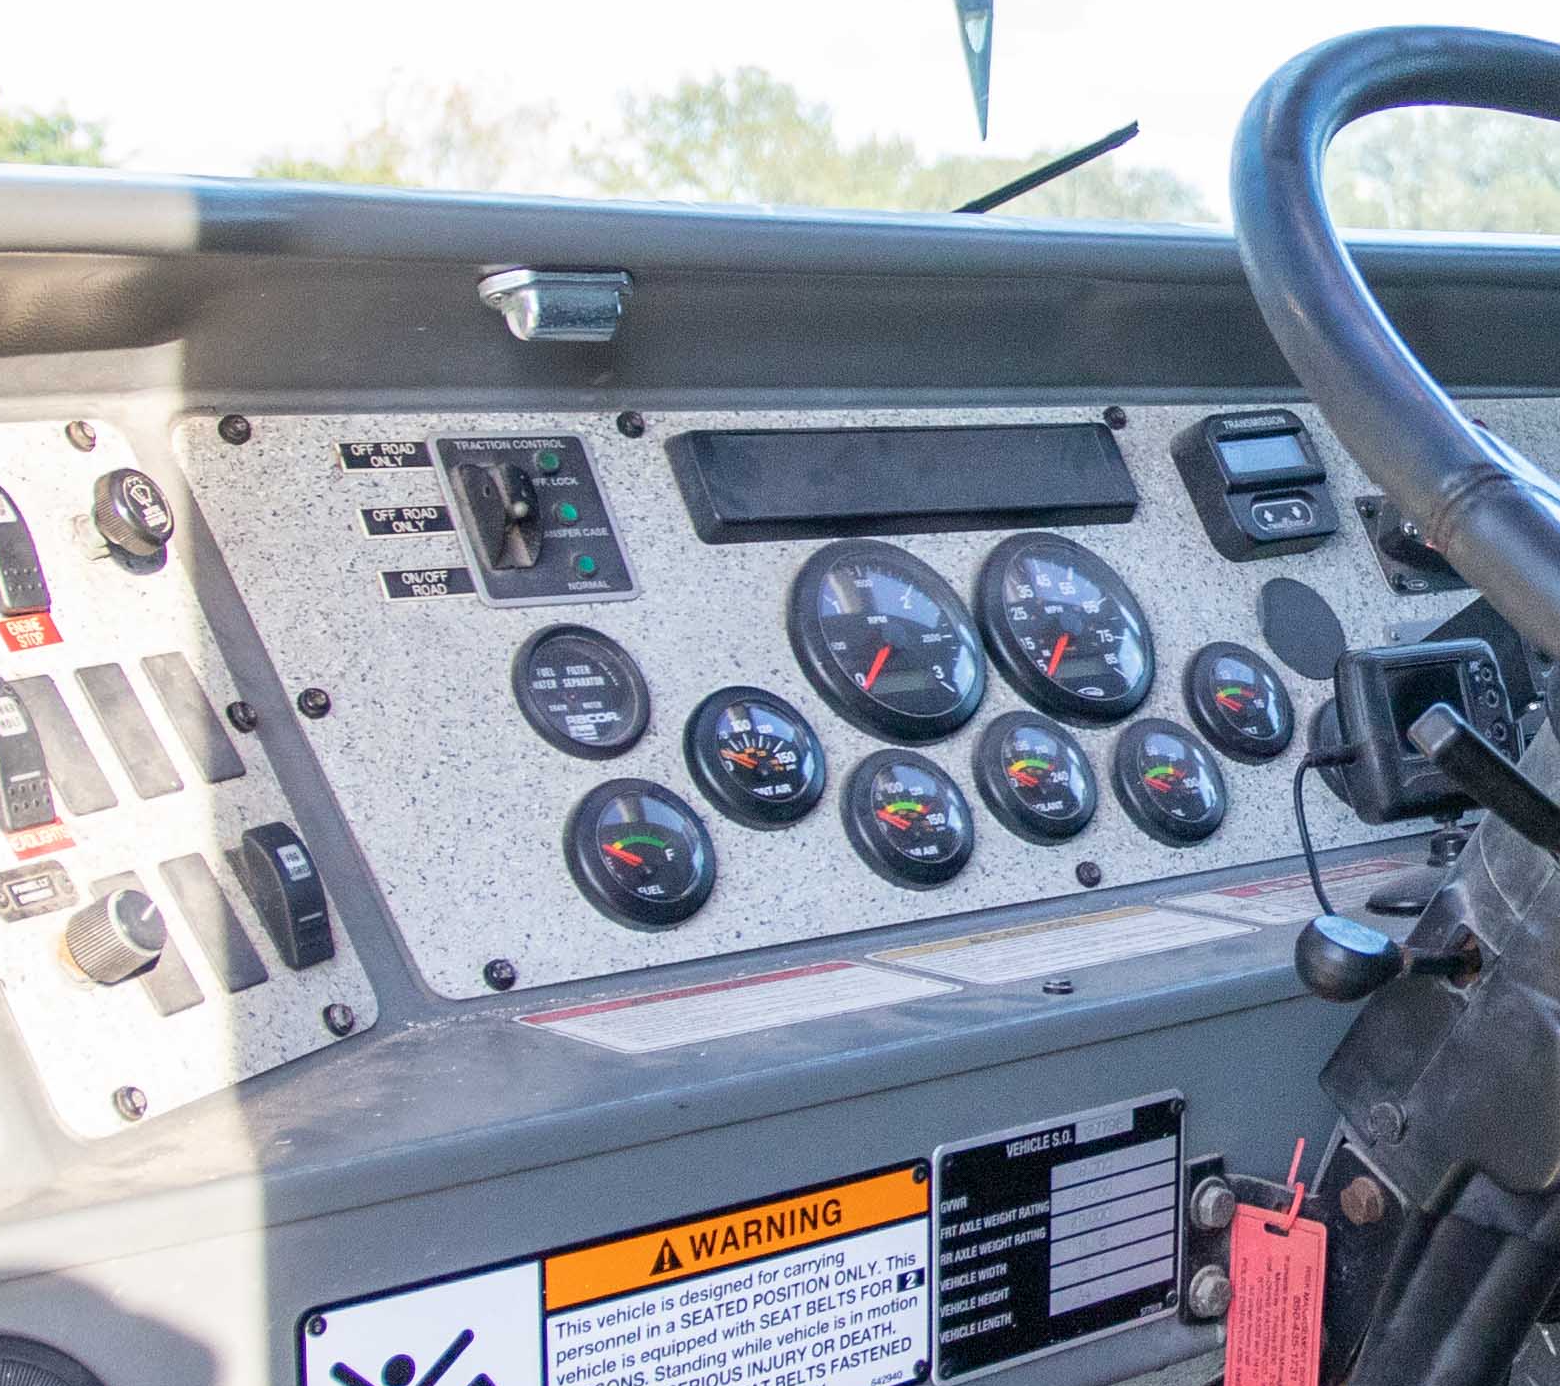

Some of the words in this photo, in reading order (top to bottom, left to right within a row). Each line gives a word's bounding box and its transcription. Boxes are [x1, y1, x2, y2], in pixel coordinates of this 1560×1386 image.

[1223, 416, 1286, 429] TRANSMISSION
[351, 444, 376, 456] OFF
[382, 443, 415, 455] ROAD
[454, 440, 511, 450] TRACTION
[514, 439, 566, 449] CONTROL
[370, 456, 403, 467] ONLY
[551, 477, 579, 486] LOCK
[372, 510, 396, 522] OFF
[403, 507, 437, 519] ROAD
[392, 521, 425, 533] ONLY
[582, 527, 609, 537] CASE
[401, 570, 448, 585] ON/OFF
[412, 584, 448, 596] ROAD
[568, 580, 611, 591] NORMAL
[1017, 584, 1034, 598] 35
[1059, 582, 1076, 595] 55
[1010, 607, 1027, 621] 25
[1044, 605, 1064, 614] MPH
[6, 618, 44, 635] ENGINE
[866, 616, 888, 624] RPM
[16, 631, 45, 648] STOP
[1096, 629, 1114, 643] 75
[1020, 637, 1035, 650] 15
[536, 667, 556, 677] FUEL
[566, 665, 591, 675] FILTER
[932, 665, 945, 680] 3
[562, 676, 605, 688] SEPARATOR
[854, 673, 866, 687] 0
[776, 751, 796, 764] 150
[1050, 771, 1068, 783] 240
[774, 784, 792, 795] AIR
[926, 814, 944, 825] 150
[664, 848, 675, 861] F
[923, 846, 938, 856] AIR
[638, 884, 664, 895] FUEL
[1006, 1133, 1050, 1158] VEHICLE
[1052, 1130, 1073, 1145] S.O.
[940, 1196, 968, 1214] GVWR
[940, 1224, 957, 1240] FRT
[959, 1218, 982, 1236] AXLE
[983, 1209, 1017, 1230] WEIGHT
[1019, 1200, 1049, 1219] RATING
[689, 1199, 842, 1262] WARNING
[940, 1254, 952, 1266] RR
[954, 1246, 978, 1263] AXLE
[979, 1237, 1013, 1256] WEIGHT
[1014, 1227, 1046, 1246] RATING
[940, 1271, 975, 1292] VEHICLE
[977, 1263, 1007, 1281] WIDTH
[556, 1319, 592, 1340] This
[597, 1301, 656, 1329] vehicle
[661, 1297, 674, 1311] is
[679, 1274, 753, 1308] designed
[758, 1268, 778, 1286] for
[784, 1251, 845, 1279] carrying
[940, 1297, 976, 1317] VEHICLE
[977, 1287, 1010, 1308] HEIGHT
[556, 1327, 641, 1367] personnel
[647, 1324, 660, 1335] in
[666, 1321, 675, 1333] a
[680, 1295, 748, 1330] SEATED
[753, 1276, 830, 1310] POSITION
[834, 1260, 881, 1286] ONLY.
[886, 1252, 916, 1272] This
[557, 1359, 616, 1386] vehicle
[622, 1354, 635, 1369] is
[641, 1329, 717, 1362] equipped
[722, 1318, 755, 1340] with
[760, 1304, 802, 1330] SEAT
[807, 1289, 856, 1317] BELTS
[861, 1279, 892, 1302] FOR
[905, 1273, 916, 1289] 2
[940, 1323, 976, 1343] VEHICLE
[978, 1313, 1012, 1333] LENGTH
[655, 1352, 726, 1382] Standing
[732, 1333, 772, 1360] while
[777, 1321, 829, 1347] vehicle
[834, 1316, 846, 1331] is
[850, 1310, 863, 1325] in
[867, 1296, 918, 1320] motion
[747, 1346, 807, 1379] INJURY
[812, 1338, 835, 1358] OR
[840, 1321, 896, 1350] DEATH.
[830, 1336, 912, 1376] FASTENED
